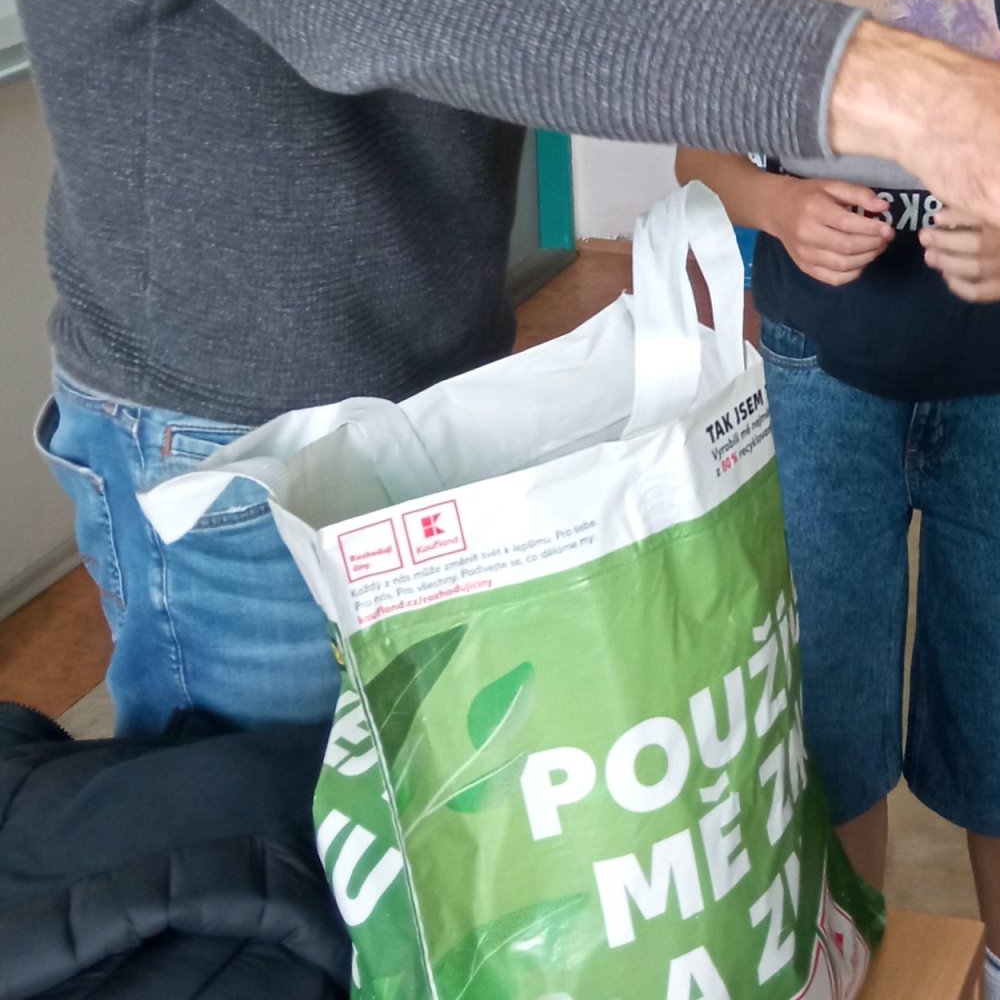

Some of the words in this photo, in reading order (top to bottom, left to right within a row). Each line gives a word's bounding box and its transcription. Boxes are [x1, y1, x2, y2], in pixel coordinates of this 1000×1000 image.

[705, 412, 734, 443] TAK
[734, 389, 764, 425] JSEM
[416, 536, 459, 554] Kaufland
[593, 772, 751, 949] MĚ
